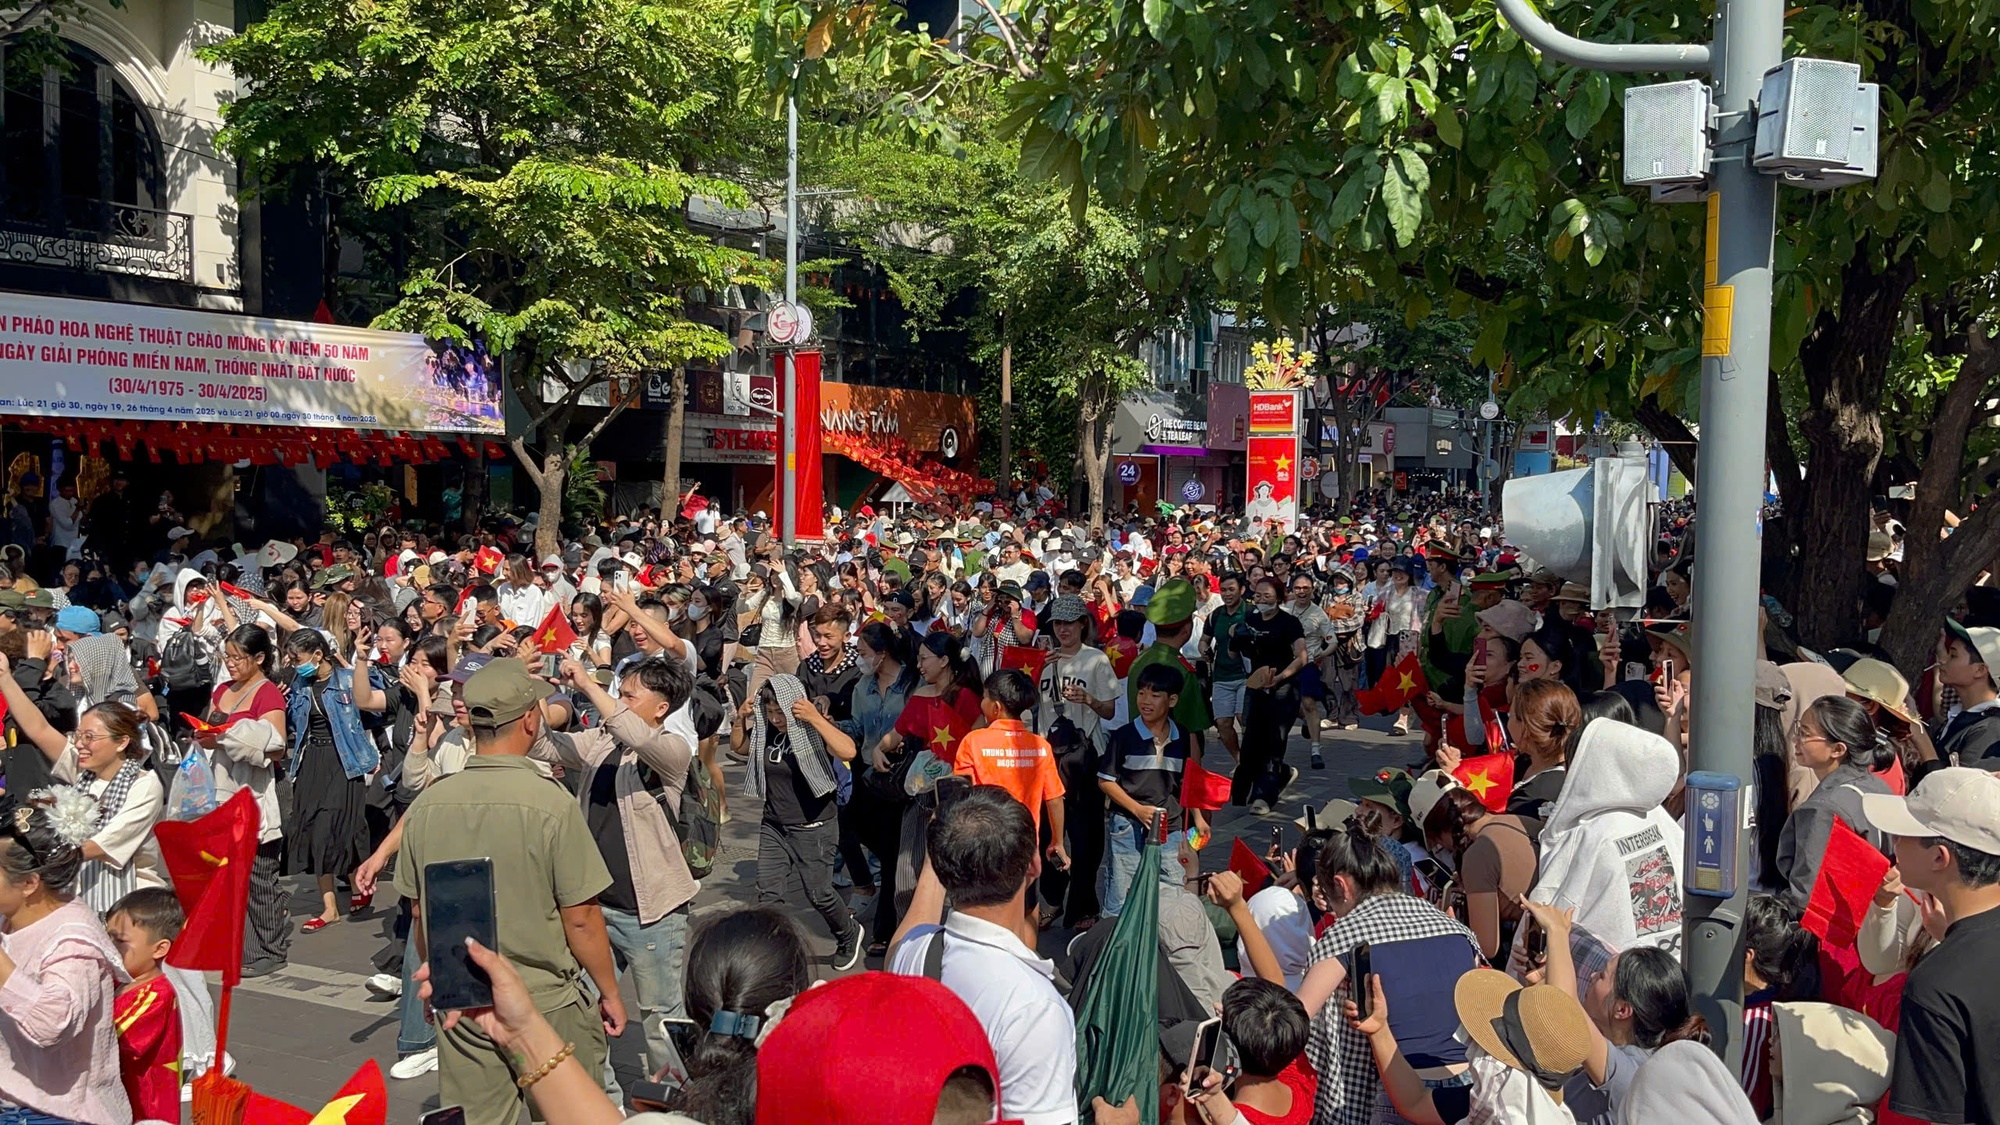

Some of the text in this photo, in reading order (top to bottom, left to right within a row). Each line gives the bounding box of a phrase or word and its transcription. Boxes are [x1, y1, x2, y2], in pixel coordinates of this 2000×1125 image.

[12, 315, 54, 335] PHÁO
[60, 320, 90, 338] HOA
[95, 323, 134, 345] NGHỆ
[139, 327, 183, 349] THUẬT
[187, 331, 223, 349] CHÀO
[227, 332, 266, 354] MỪNG
[270, 335, 286, 355] KỶ
[290, 338, 321, 360] NIỆM
[324, 343, 339, 359] 50
[342, 344, 369, 361] NĂM
[41, 341, 72, 364] GIẢI
[77, 347, 127, 367] PHÓNG
[175, 356, 211, 374] NAM,
[215, 356, 257, 377] THỐNG
[261, 359, 294, 379] NHẤT
[298, 361, 320, 381] ĐẤT
[324, 366, 356, 383] NƯỚC
[108, 377, 184, 396] (30/4/1975
[198, 383, 268, 404] 30/4/2025)
[17, 399, 34, 407] Lúc
[37, 400, 47, 408] 21
[51, 401, 66, 411] giờ
[69, 402, 83, 411] 30,
[86, 402, 108, 413] ngày
[111, 403, 124, 412] 19,
[126, 404, 138, 412] 26
[140, 404, 165, 416] tháng
[167, 406, 173, 414] 4
[175, 406, 193, 415] năm
[196, 408, 216, 416] 2025
[218, 408, 228, 416] và
[230, 409, 242, 417] lúc
[244, 409, 253, 418] 21
[270, 411, 280, 419] 00
[281, 411, 300, 422] ngày
[302, 413, 311, 421] 30
[313, 413, 335, 423] tháng
[336, 414, 341, 422] 4
[343, 414, 358, 423] năm
[360, 415, 377, 423] 2025
[869, 400, 899, 434] TẤM
[1253, 402, 1284, 411] HDBank
[1163, 418, 1208, 431] THE COFFEE BEAN
[1167, 431, 1179, 441] TEA
[1179, 431, 1192, 442] LEAF
[1121, 464, 1135, 477] 24
[981, 748, 1005, 757] TRUNG
[1616, 824, 1663, 855] INTERBREAK
